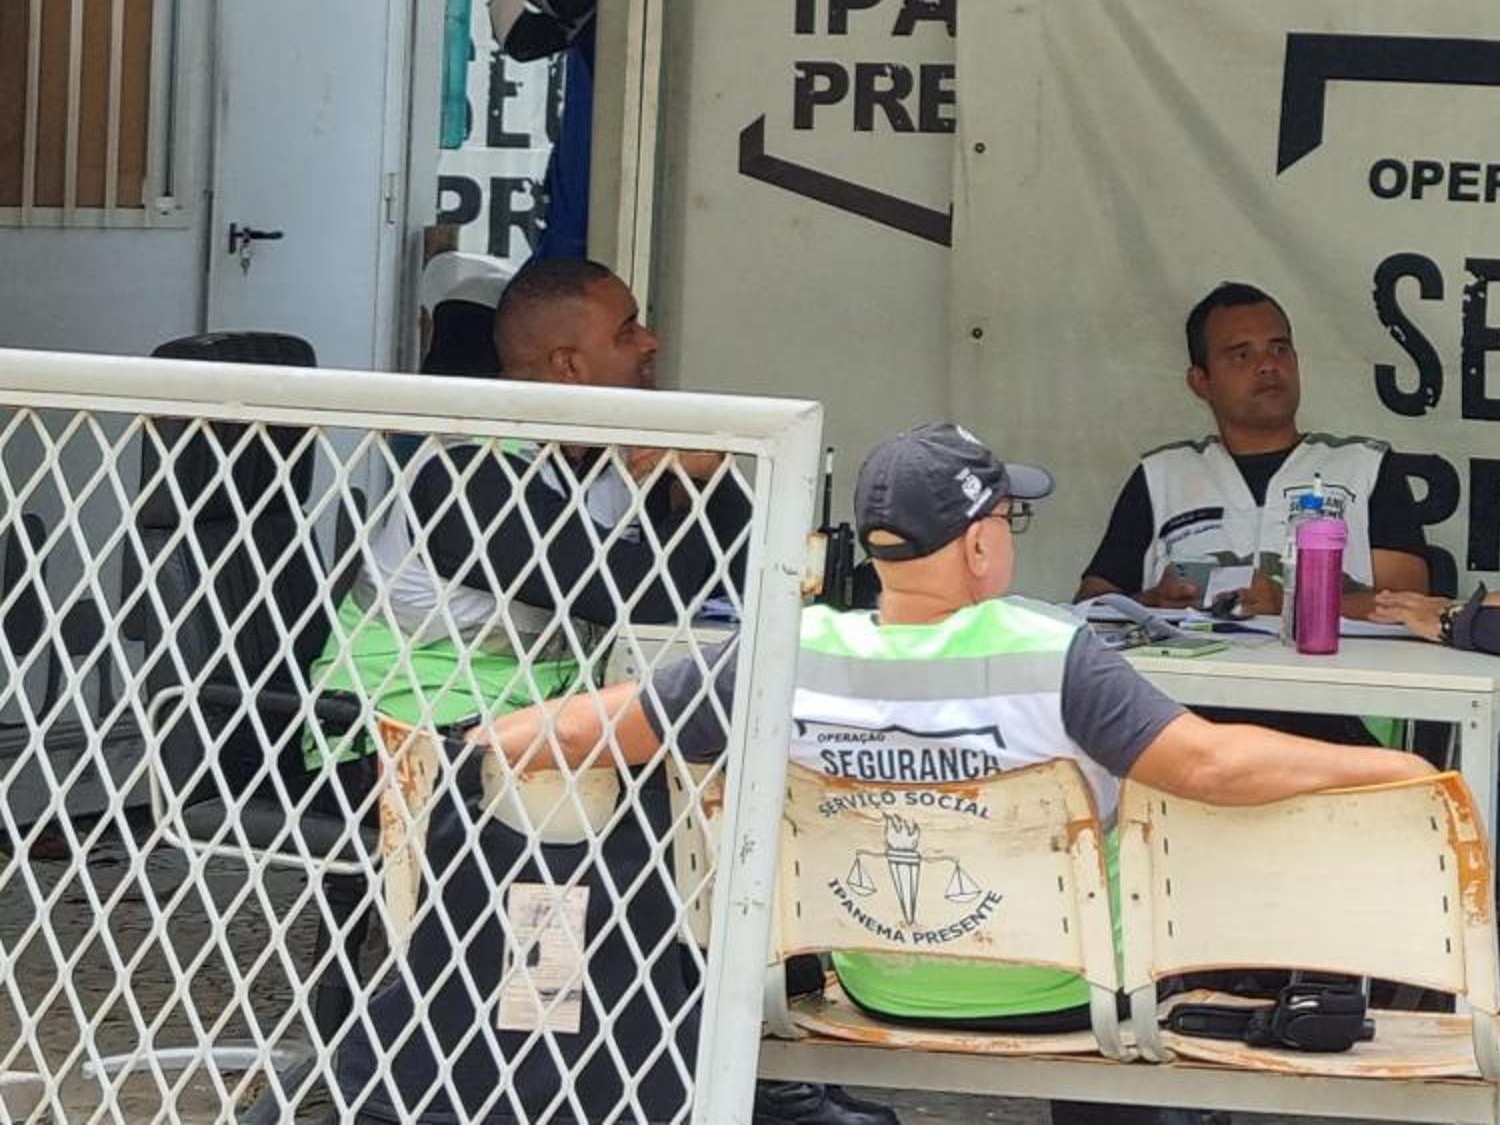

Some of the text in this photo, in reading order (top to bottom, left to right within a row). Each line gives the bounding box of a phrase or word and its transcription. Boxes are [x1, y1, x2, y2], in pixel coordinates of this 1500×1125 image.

[817, 731, 885, 744] OPERAÇÃO
[818, 790, 992, 820] SERVIÇO SOCIAL
[828, 878, 1003, 946] IPANEMA PRESENTE
